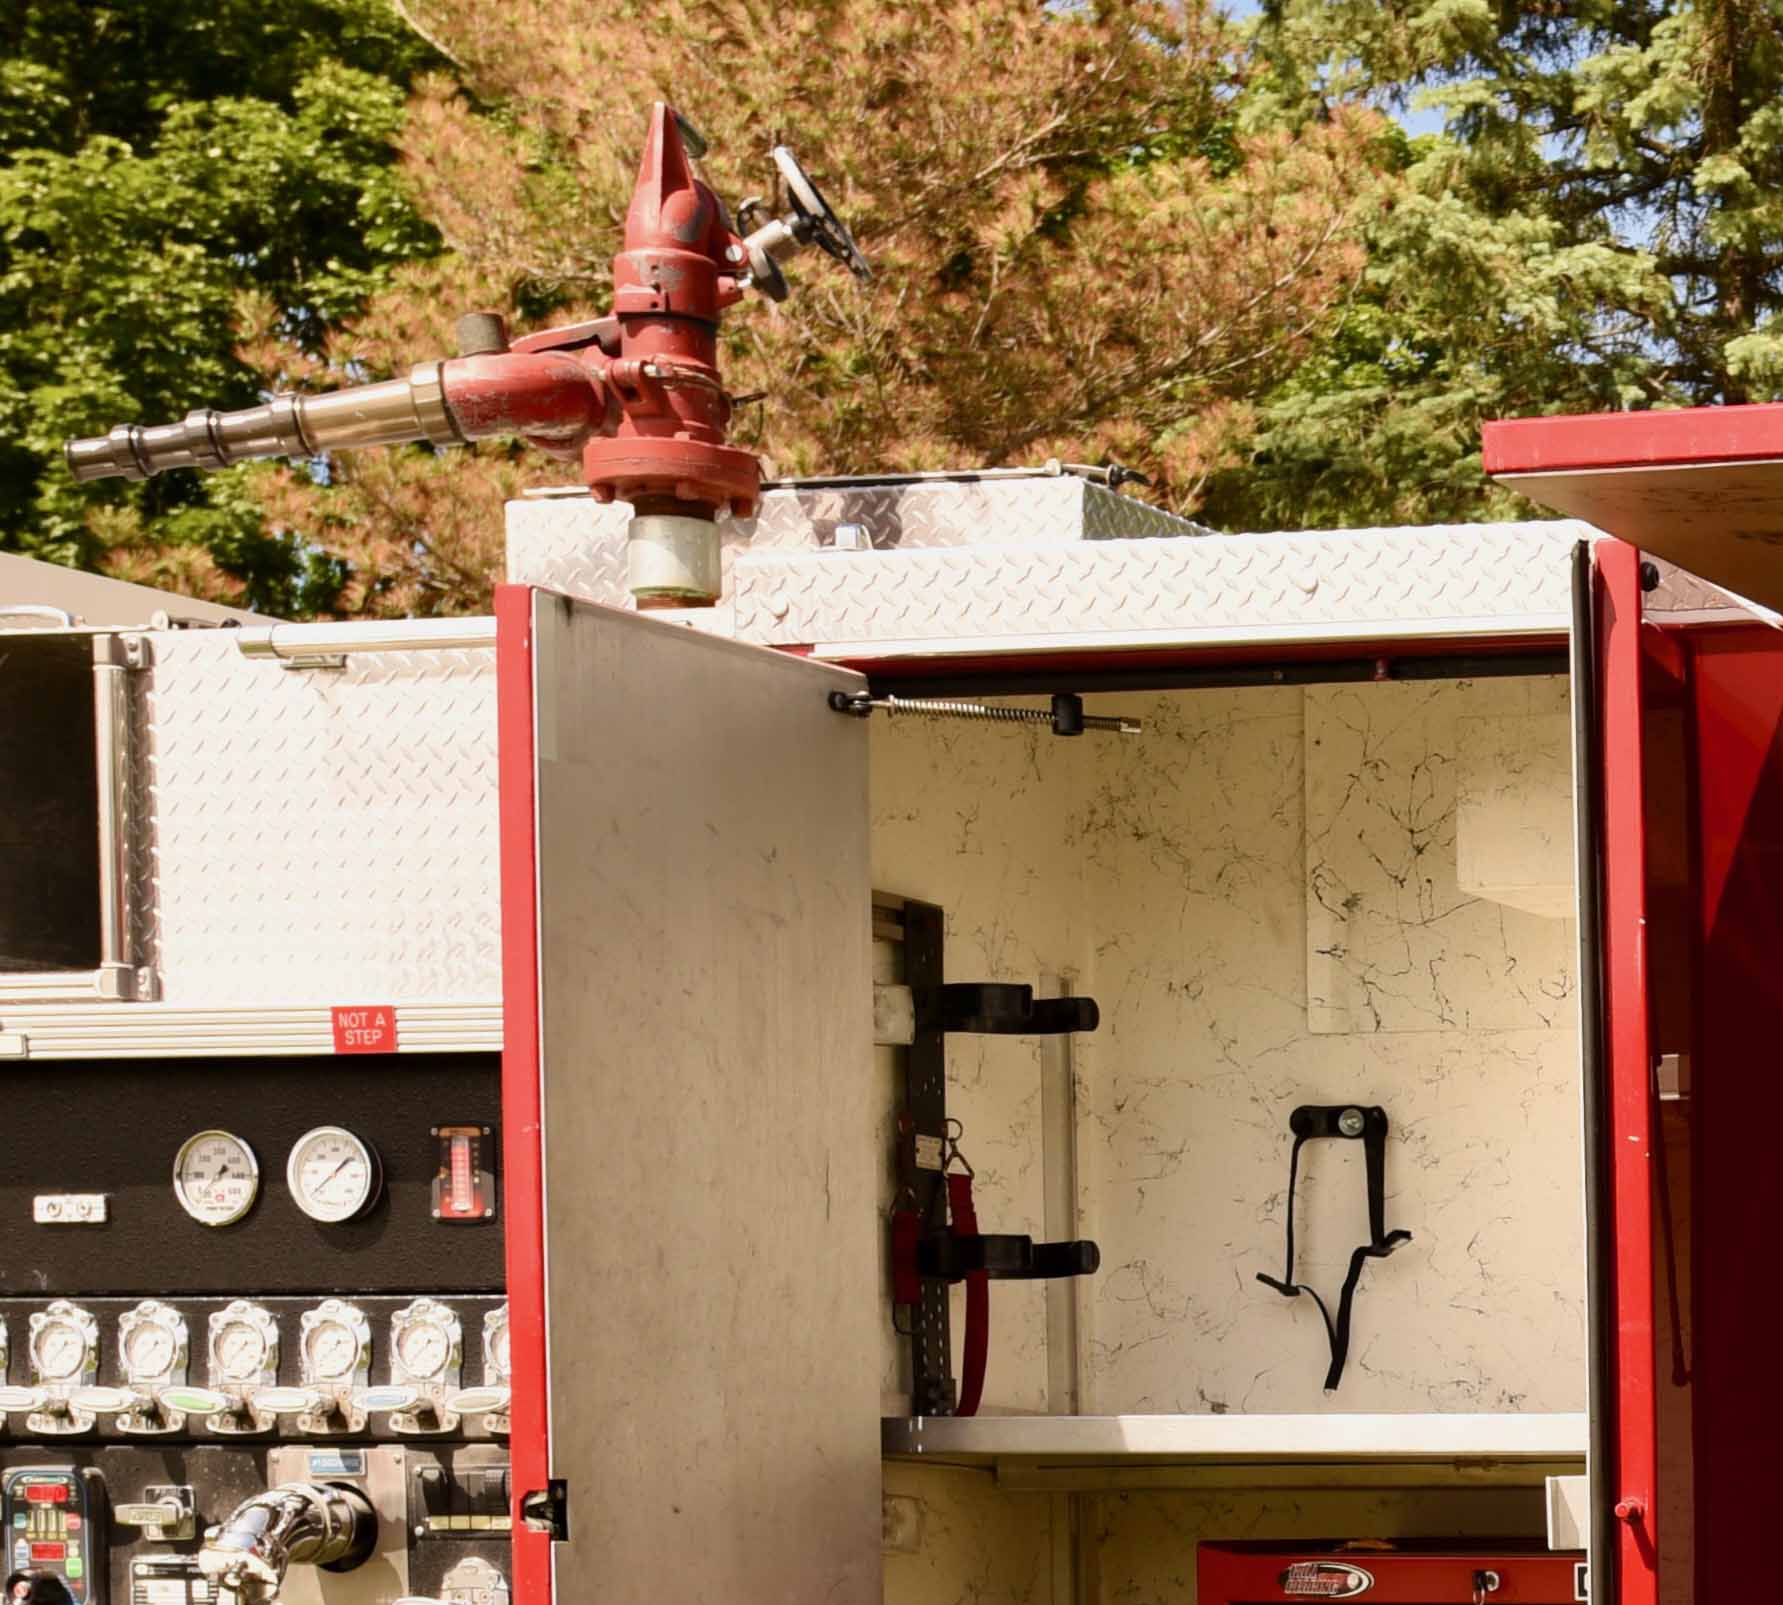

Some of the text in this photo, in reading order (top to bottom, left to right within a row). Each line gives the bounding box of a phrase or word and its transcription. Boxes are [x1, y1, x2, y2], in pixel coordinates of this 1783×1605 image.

[338, 1011, 386, 1028] NOT A
[344, 1029, 383, 1046] STEP
